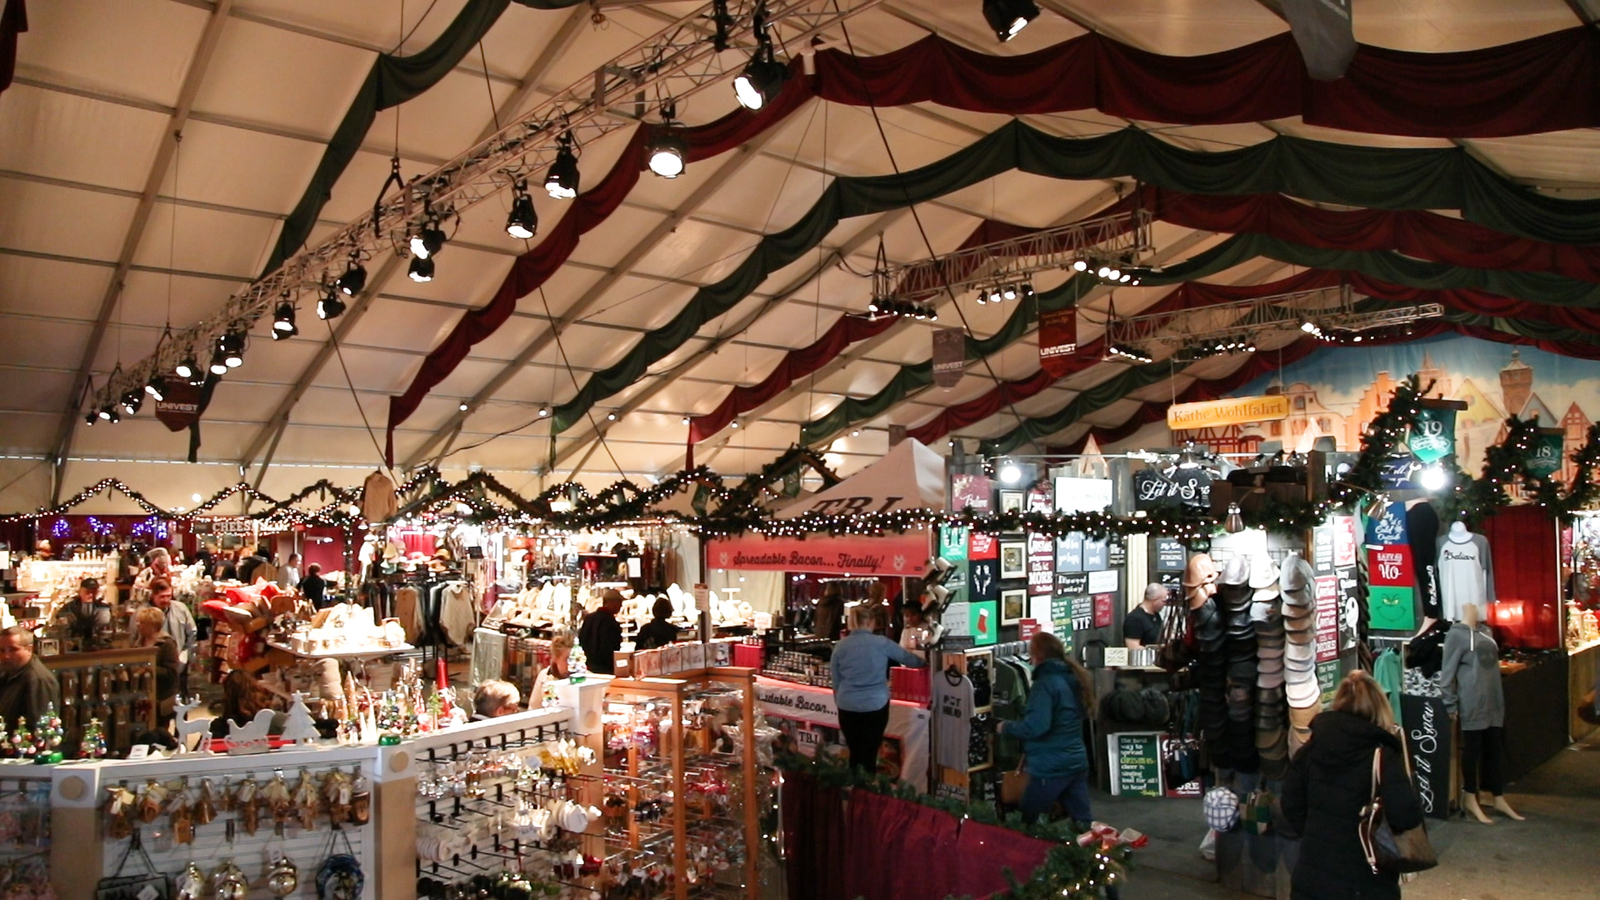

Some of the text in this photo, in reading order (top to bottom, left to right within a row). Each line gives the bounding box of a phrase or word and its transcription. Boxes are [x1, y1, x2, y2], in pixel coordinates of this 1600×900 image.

[1040, 343, 1076, 356] UNIVEST
[933, 361, 964, 371] UNIVEST
[156, 402, 198, 411] UNIVEST
[1173, 402, 1283, 423] Käthe Wohlfahrt
[1423, 421, 1442, 437] 19
[1535, 446, 1551, 458] 18
[1139, 478, 1167, 500] Let
[212, 520, 257, 532] CHEES
[733, 551, 885, 570] Spreadable Bacon... Finally!
[1028, 571, 1053, 585] MORE
[1072, 617, 1091, 631] WTF
[795, 695, 838, 715] Bacon...
[1411, 702, 1438, 754] Snow
[798, 731, 819, 745] TBJ
